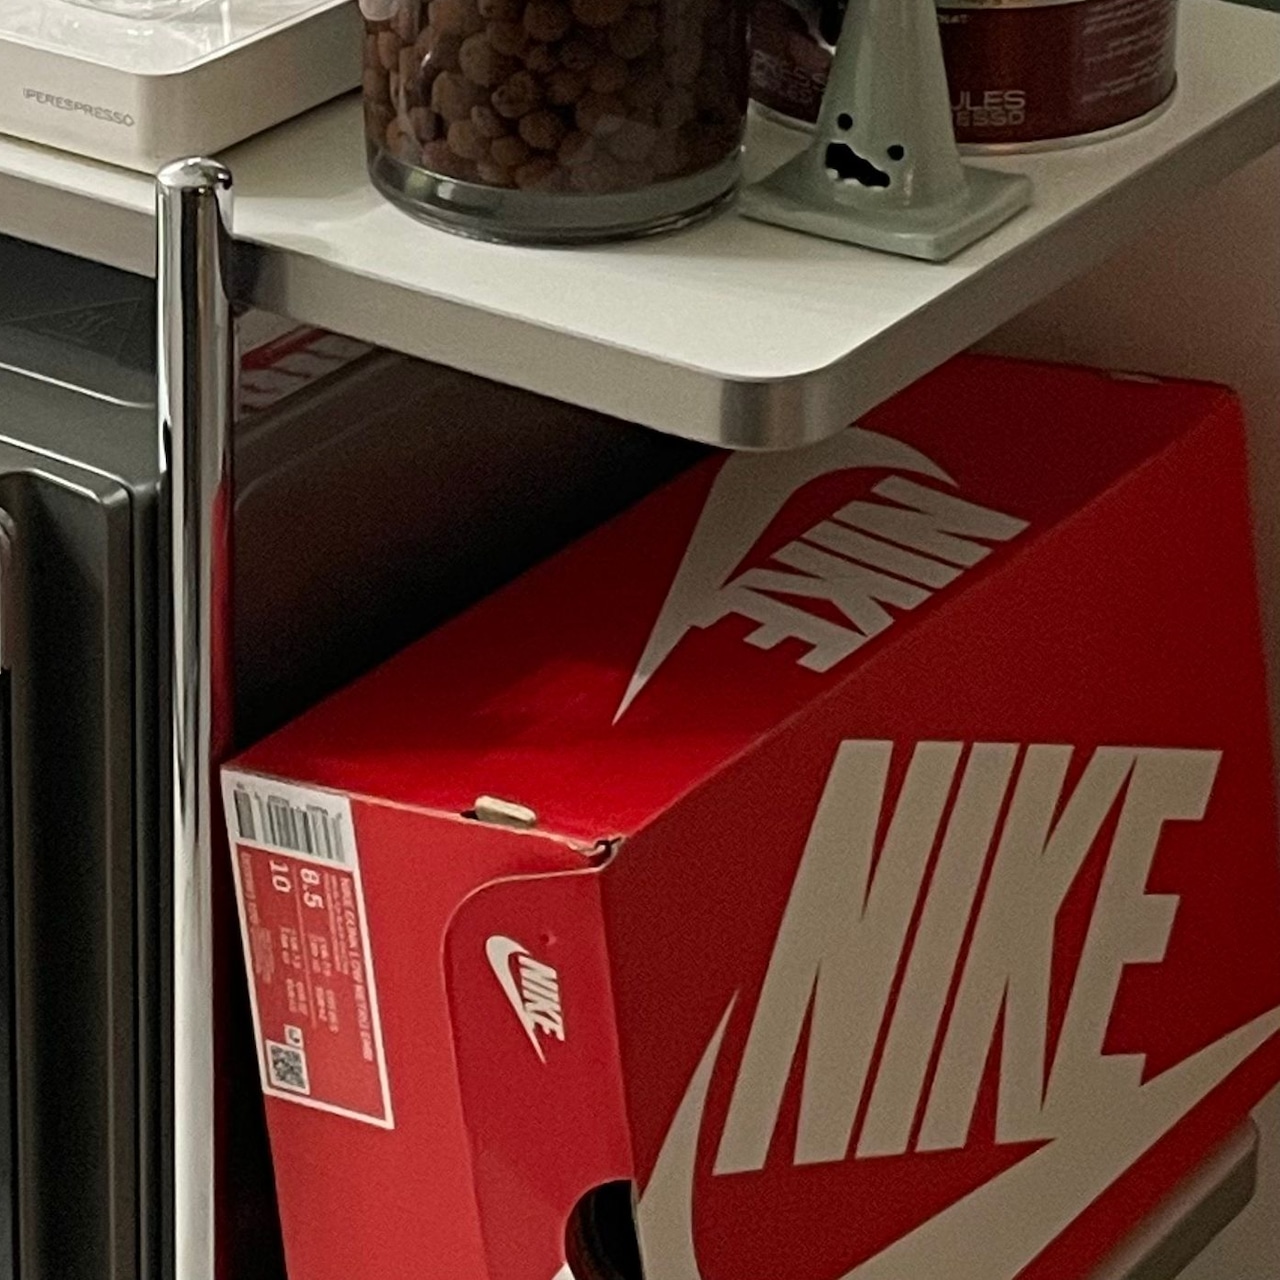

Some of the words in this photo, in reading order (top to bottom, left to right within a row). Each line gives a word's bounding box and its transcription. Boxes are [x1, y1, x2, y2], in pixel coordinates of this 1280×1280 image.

[22, 87, 135, 128] IPERESPRESSO
[700, 475, 1032, 673] NIKE
[268, 859, 291, 894] 10
[298, 866, 324, 910] 8.5
[712, 739, 1223, 1177] NIKE
[518, 955, 565, 1041] NIKE
